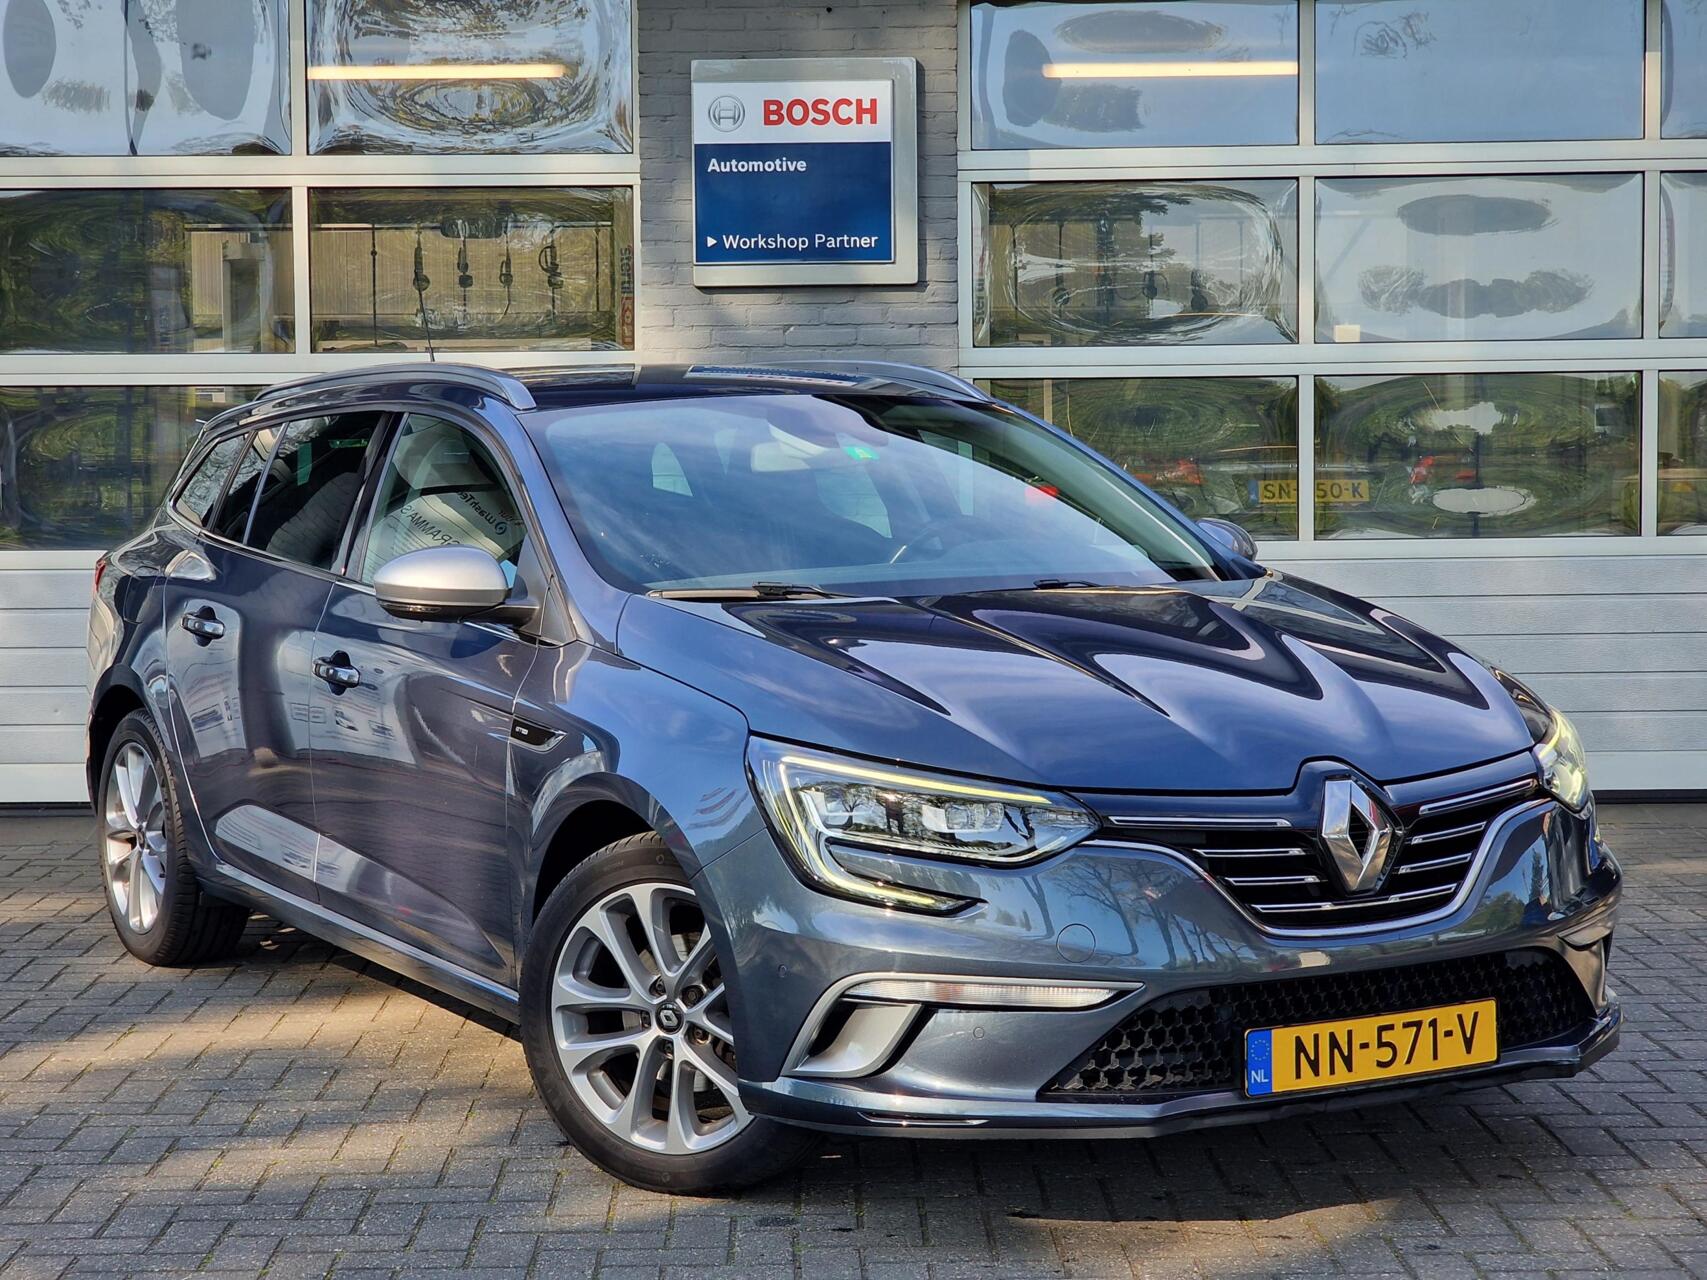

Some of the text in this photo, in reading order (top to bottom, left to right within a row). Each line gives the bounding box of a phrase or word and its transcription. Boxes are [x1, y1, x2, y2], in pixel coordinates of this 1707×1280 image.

[763, 98, 878, 126] BOSCH
[707, 157, 808, 173] Automotive
[722, 233, 879, 252] Workshop Partner
[1294, 1011, 1480, 1080] NN-571-V
[1250, 1068, 1269, 1084] NL
